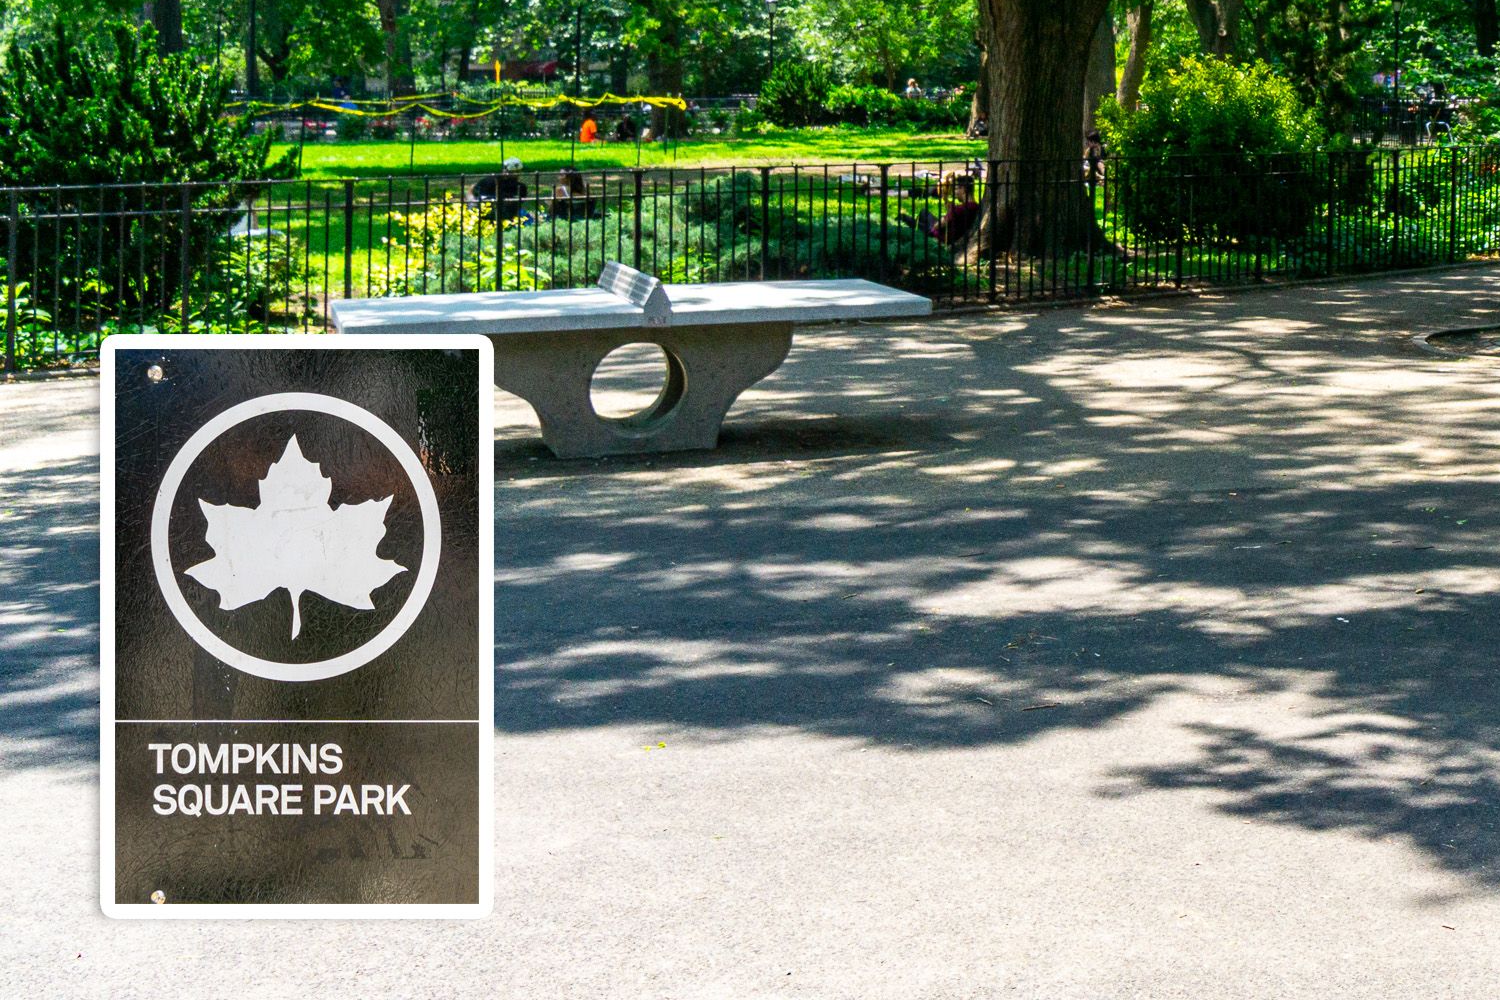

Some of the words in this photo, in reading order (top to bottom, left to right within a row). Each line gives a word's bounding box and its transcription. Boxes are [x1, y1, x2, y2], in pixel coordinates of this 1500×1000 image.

[148, 742, 344, 775] TOMPKINS
[152, 783, 304, 818] SQUARE
[313, 784, 413, 816] PARK
